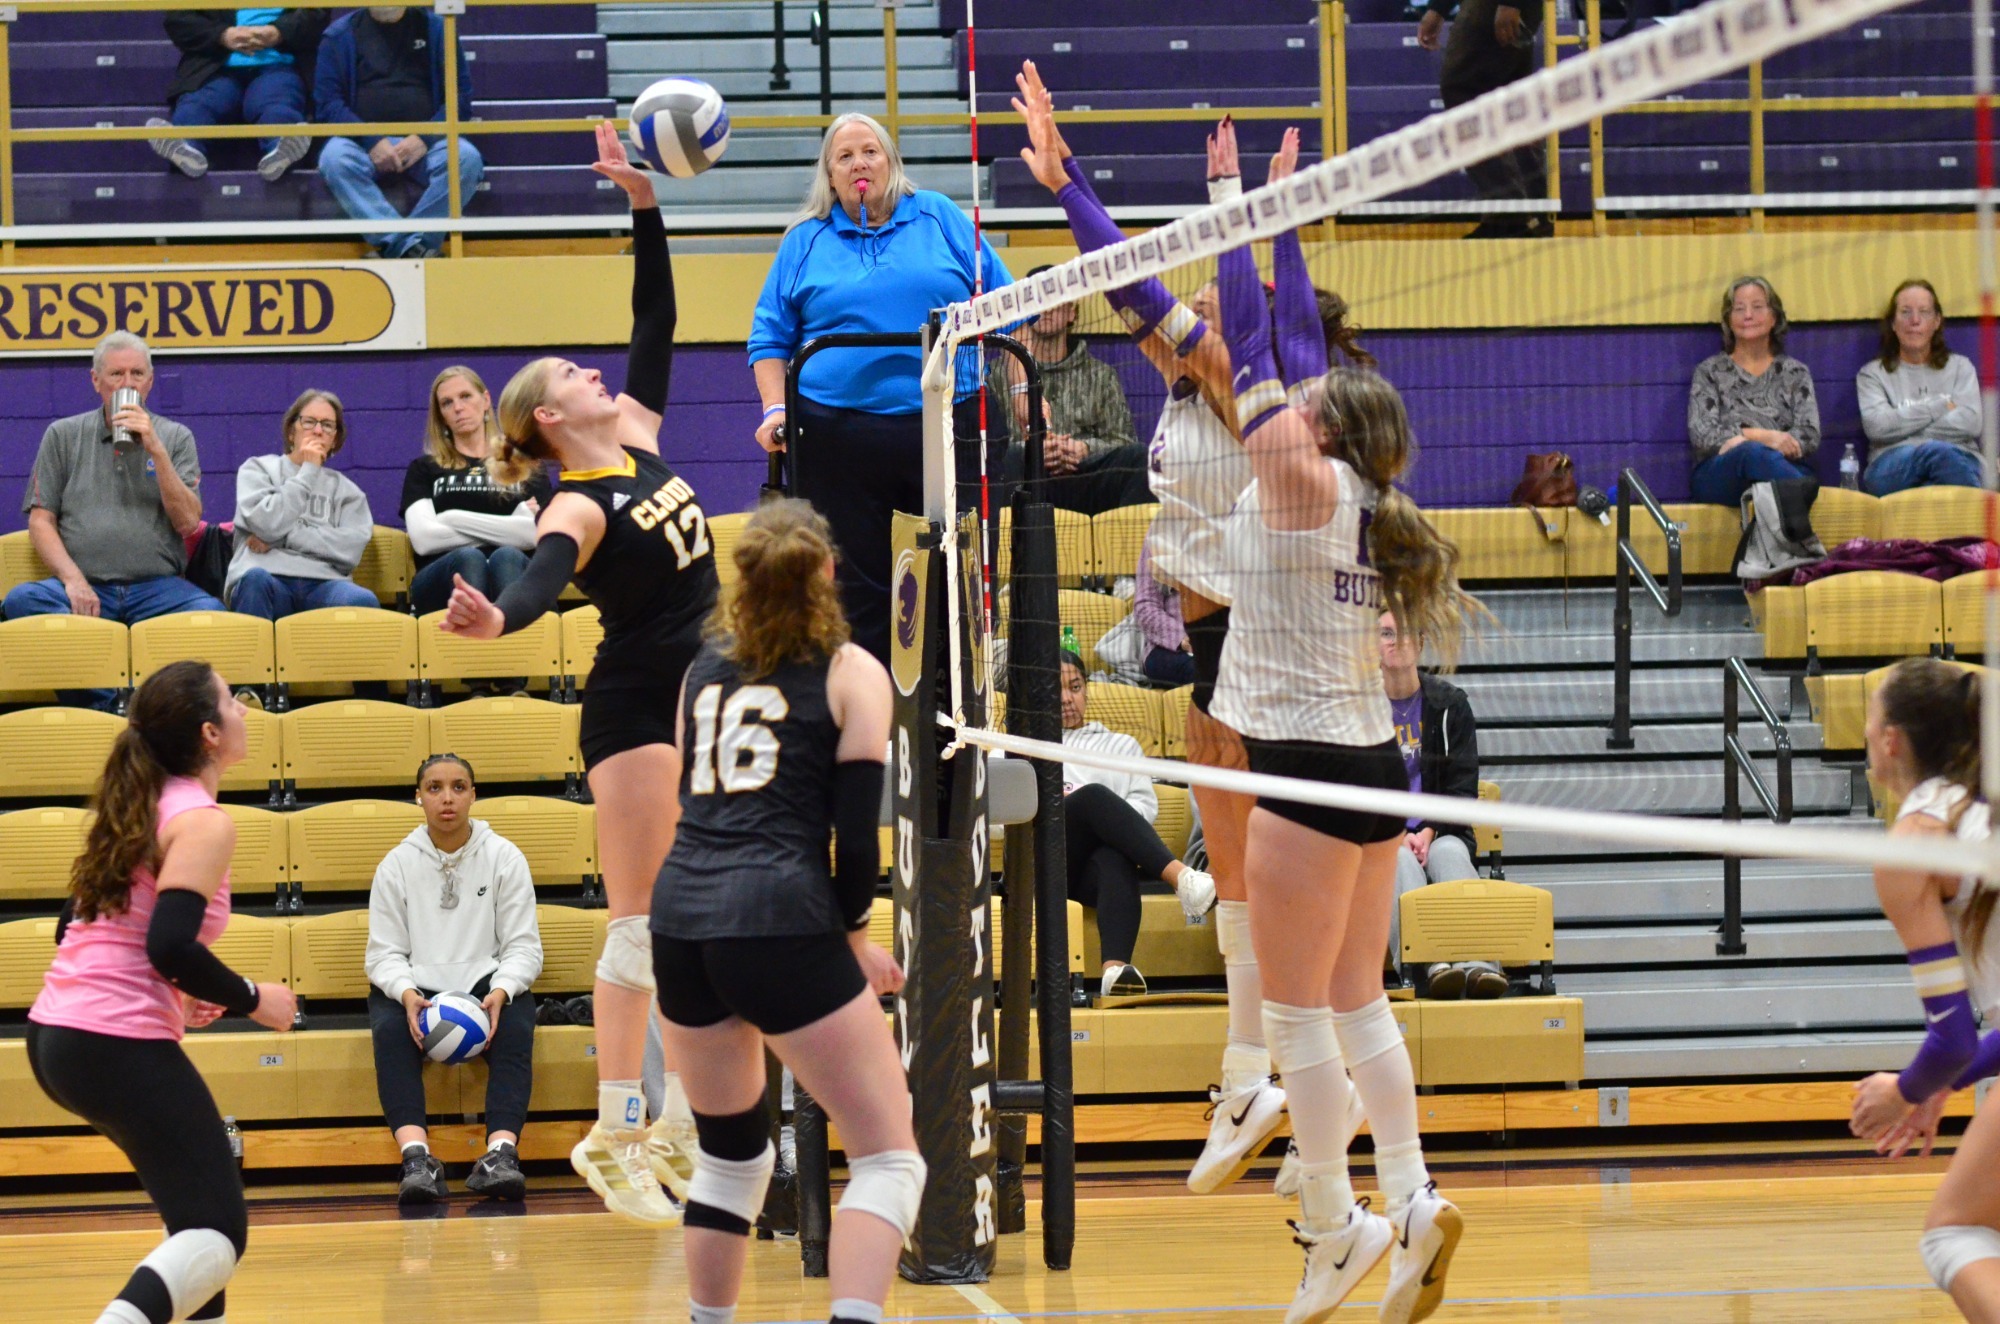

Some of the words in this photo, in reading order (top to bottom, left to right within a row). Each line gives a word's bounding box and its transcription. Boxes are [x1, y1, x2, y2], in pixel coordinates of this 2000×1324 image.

[663, 503, 710, 571] 12
[690, 683, 790, 795] 16
[1191, 915, 1202, 924] 32
[1549, 1019, 1560, 1028] 32
[1073, 1032, 1084, 1040] 29
[591, 1046, 597, 1055] 2
[266, 1056, 277, 1065] 24
